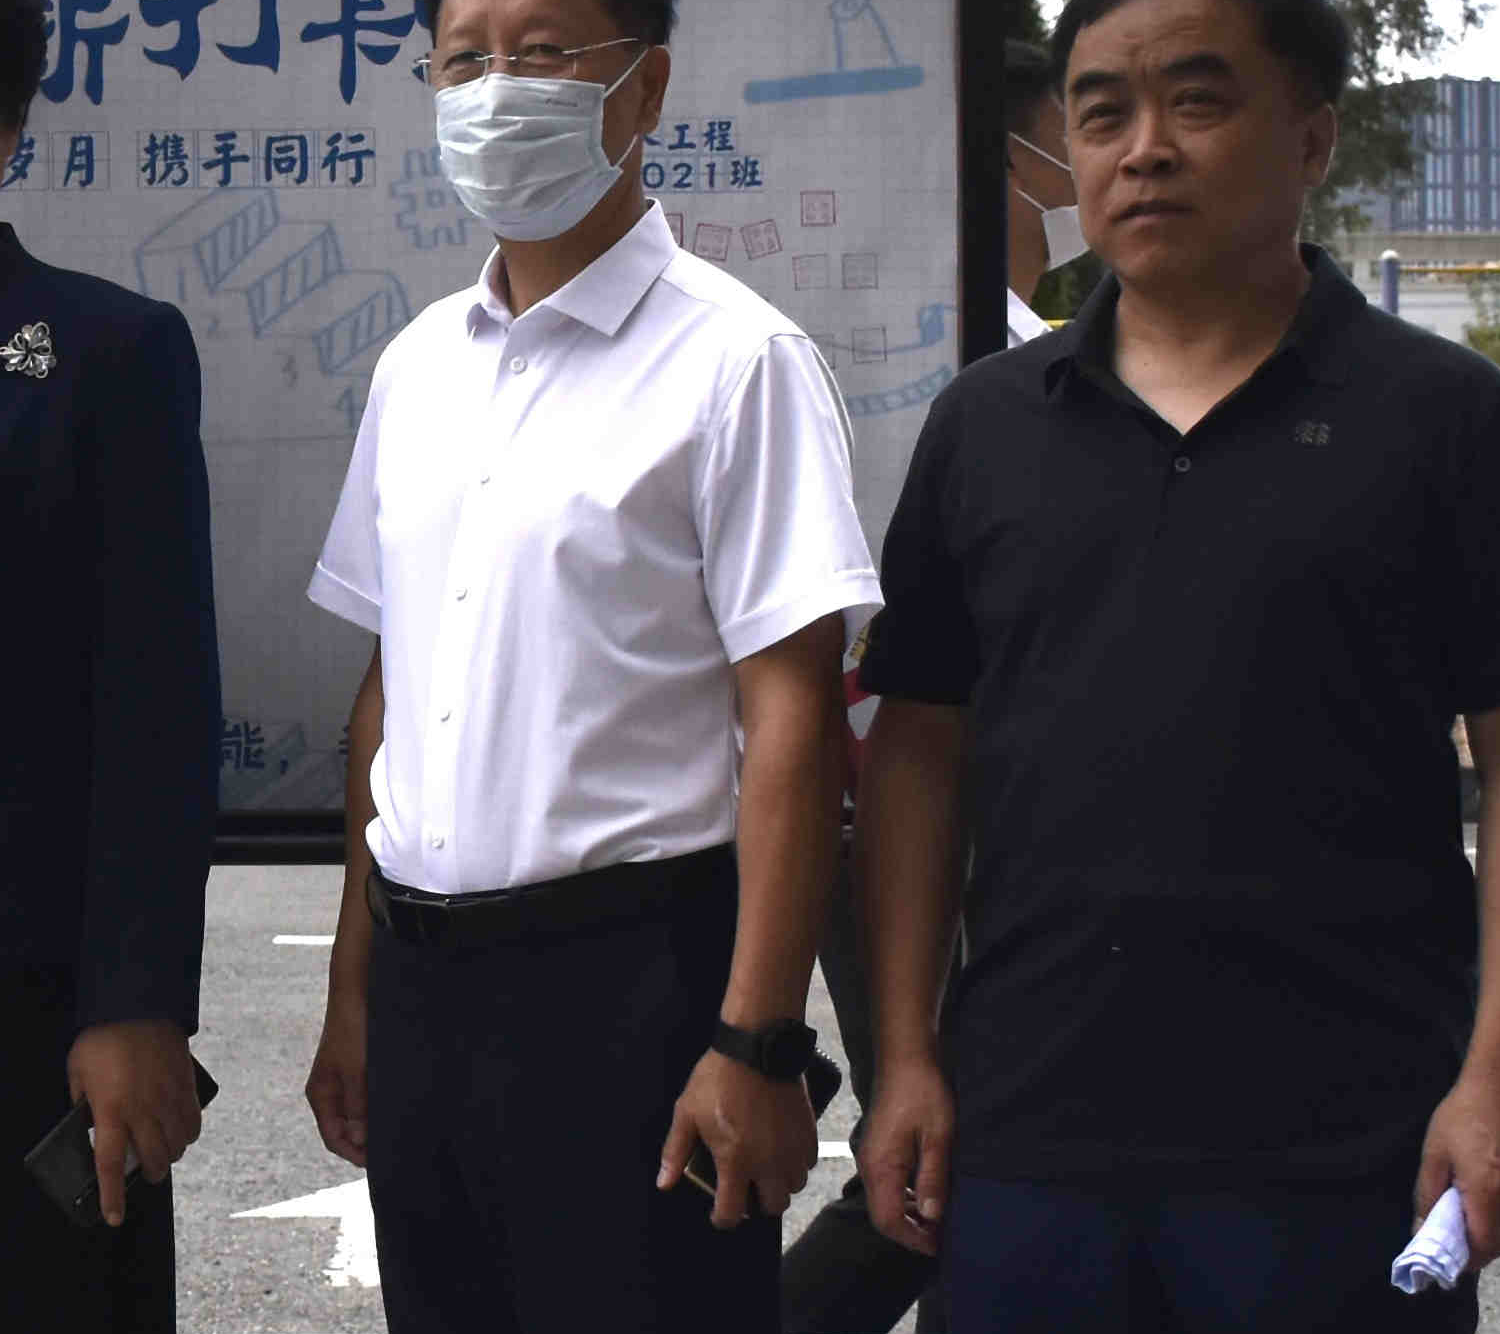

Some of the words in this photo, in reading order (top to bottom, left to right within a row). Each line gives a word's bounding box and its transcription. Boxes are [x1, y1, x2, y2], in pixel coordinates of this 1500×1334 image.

[642, 120, 735, 152] 工程
[141, 131, 375, 188] 携手同行
